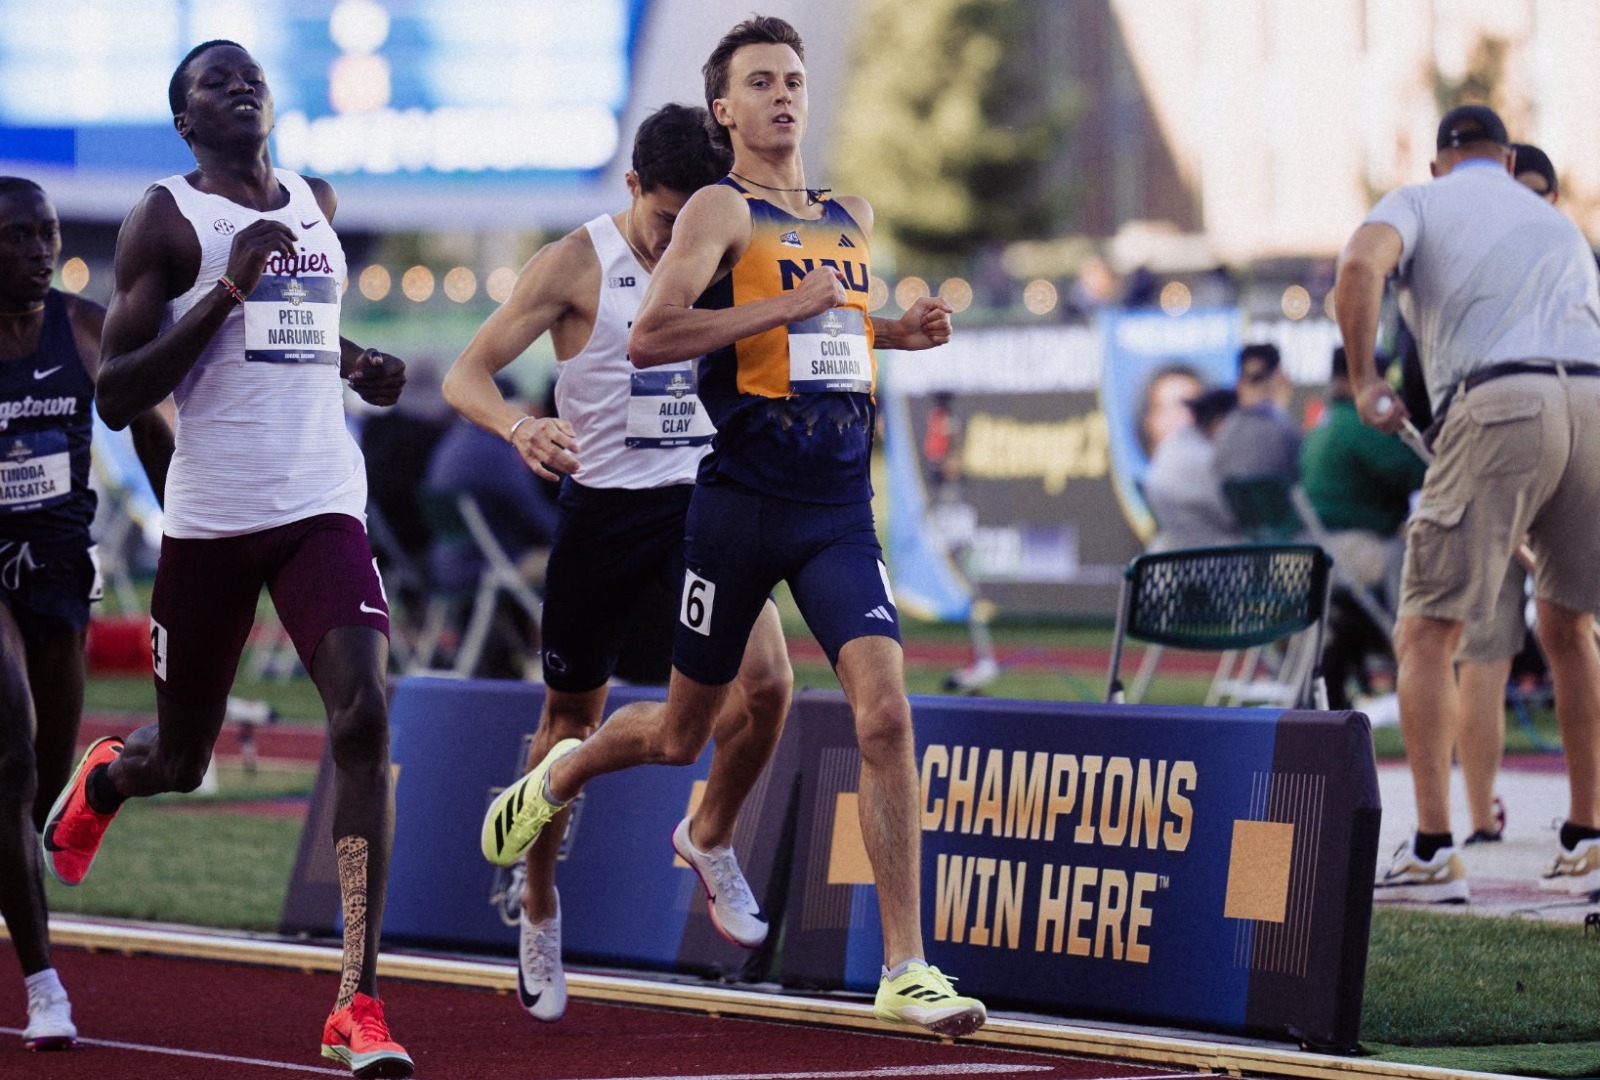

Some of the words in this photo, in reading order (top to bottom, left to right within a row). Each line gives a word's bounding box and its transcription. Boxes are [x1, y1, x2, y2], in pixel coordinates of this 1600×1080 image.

[279, 309, 314, 325] PETER
[268, 328, 326, 345] NARUMBE
[820, 340, 850, 357] COLIN
[811, 360, 861, 375] SAHLMAN
[659, 401, 696, 416] ALLON
[662, 419, 691, 433] CLAY
[687, 579, 707, 628] 6
[920, 744, 1197, 851] CHAMPIONS
[934, 853, 1027, 950] WIN
